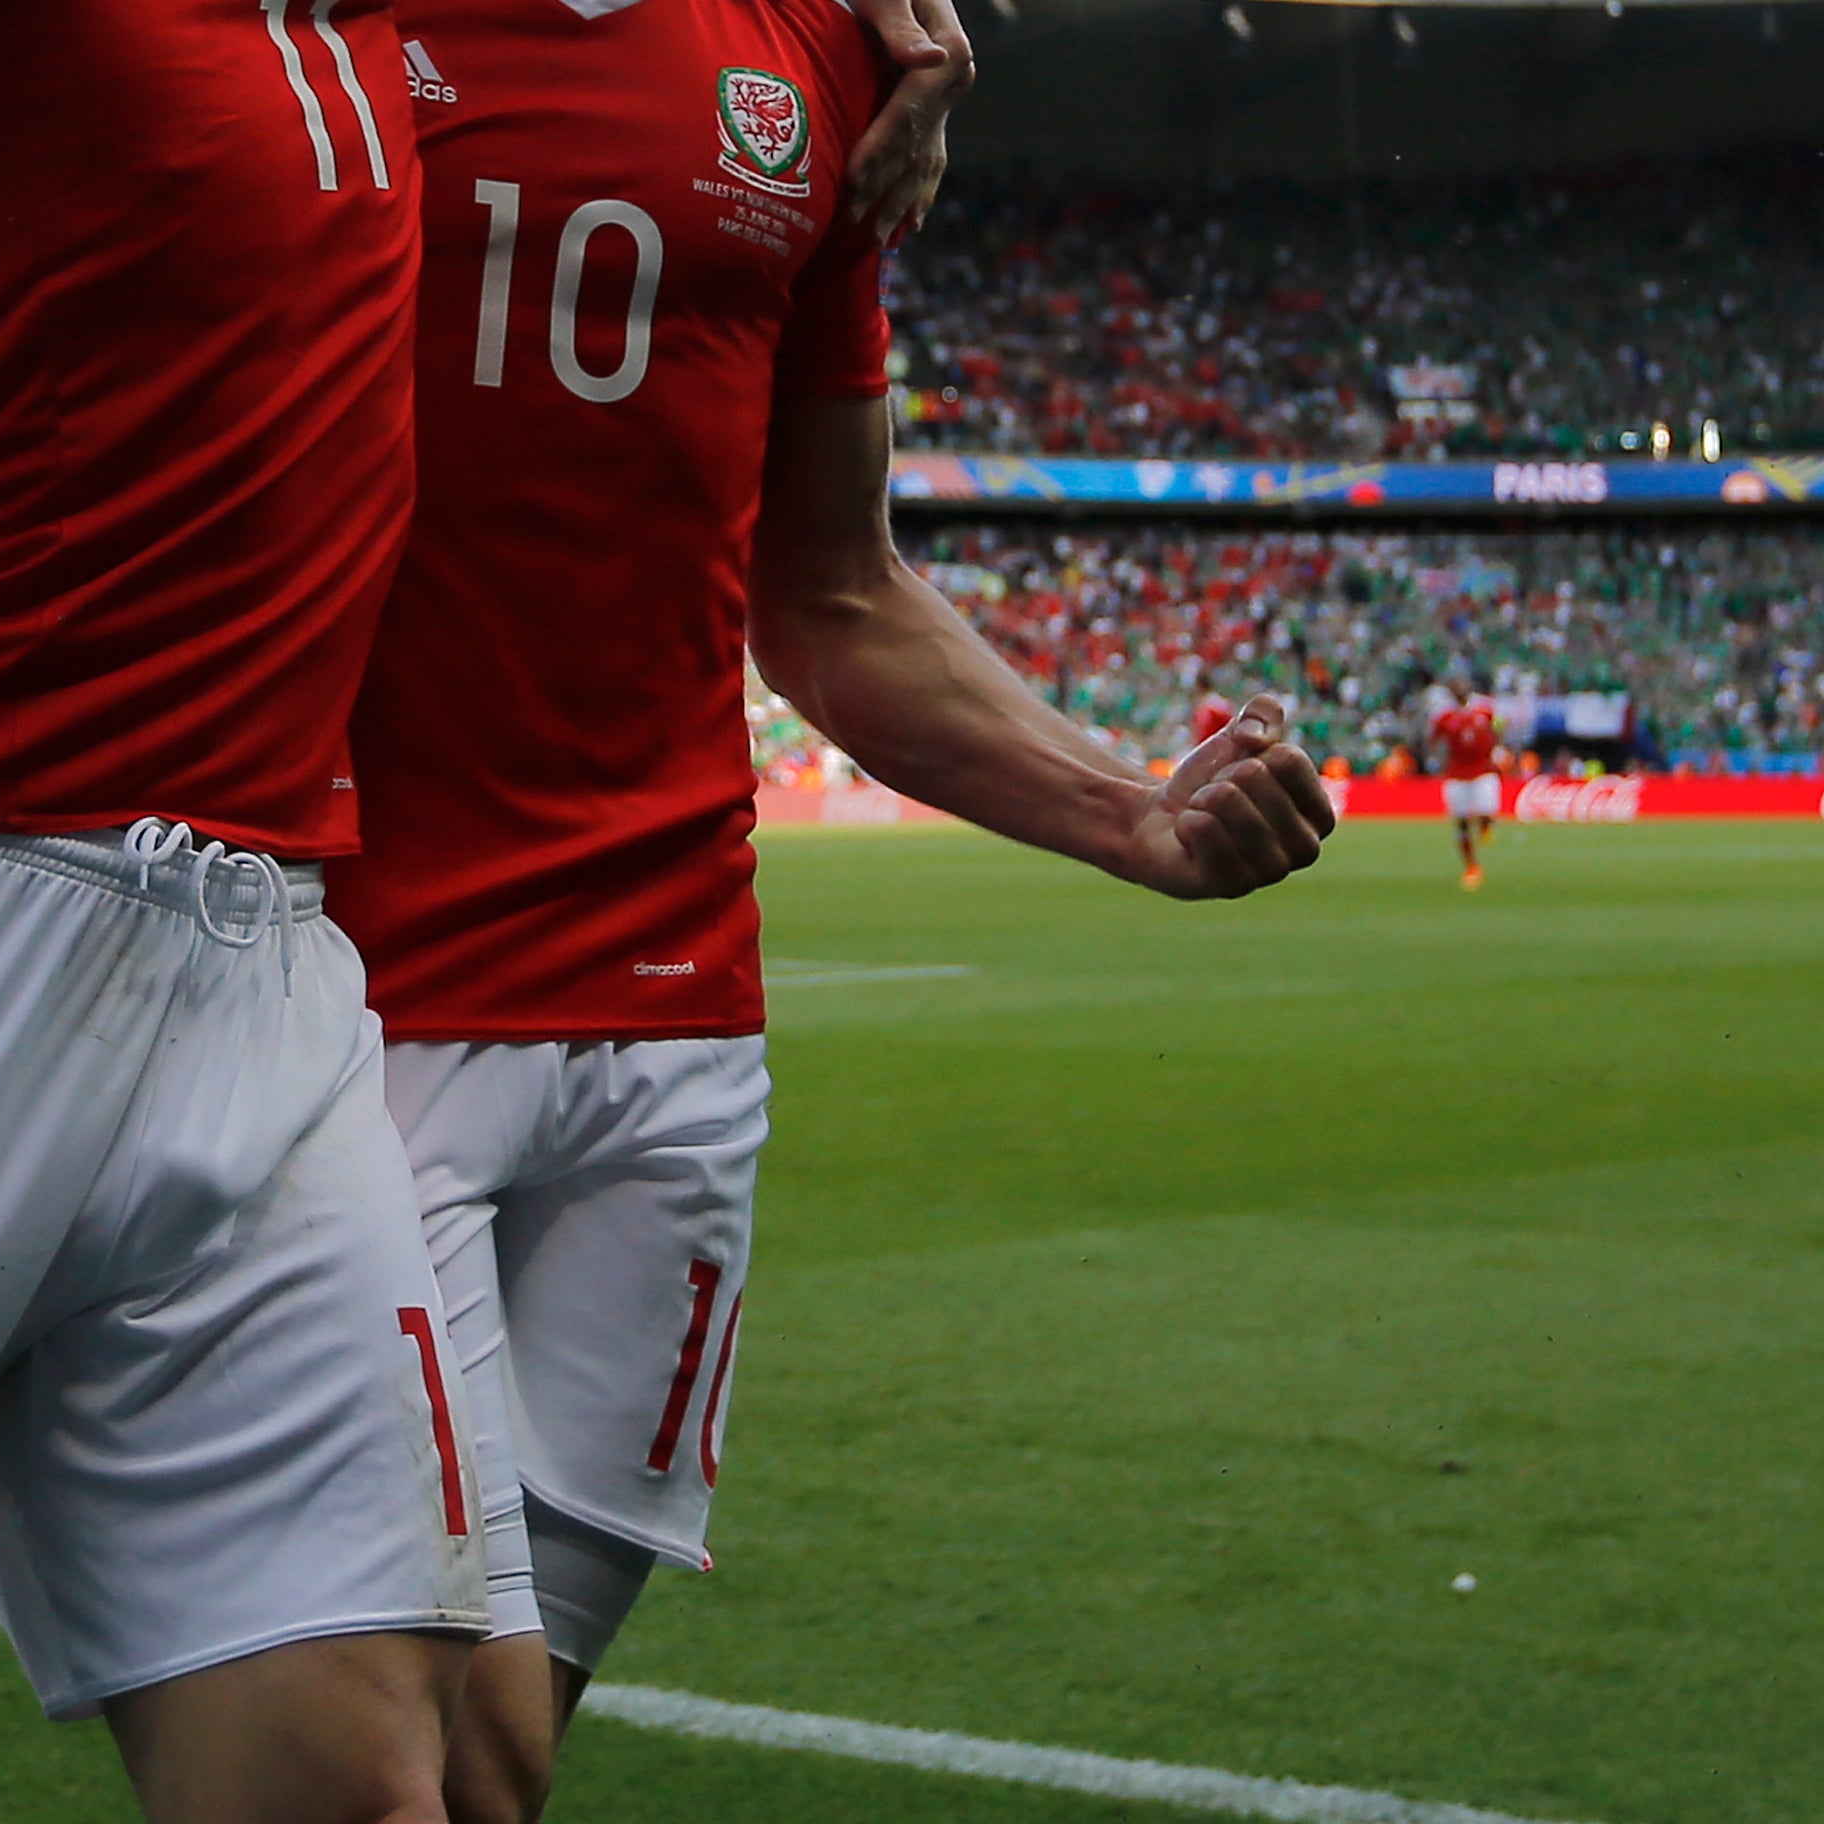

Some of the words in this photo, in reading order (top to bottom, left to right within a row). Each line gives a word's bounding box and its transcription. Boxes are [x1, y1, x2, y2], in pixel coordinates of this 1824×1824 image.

[692, 177, 730, 199] WALES
[473, 178, 664, 404] 10
[1492, 460, 1608, 505] PARIS
[396, 1306, 470, 1536] 1
